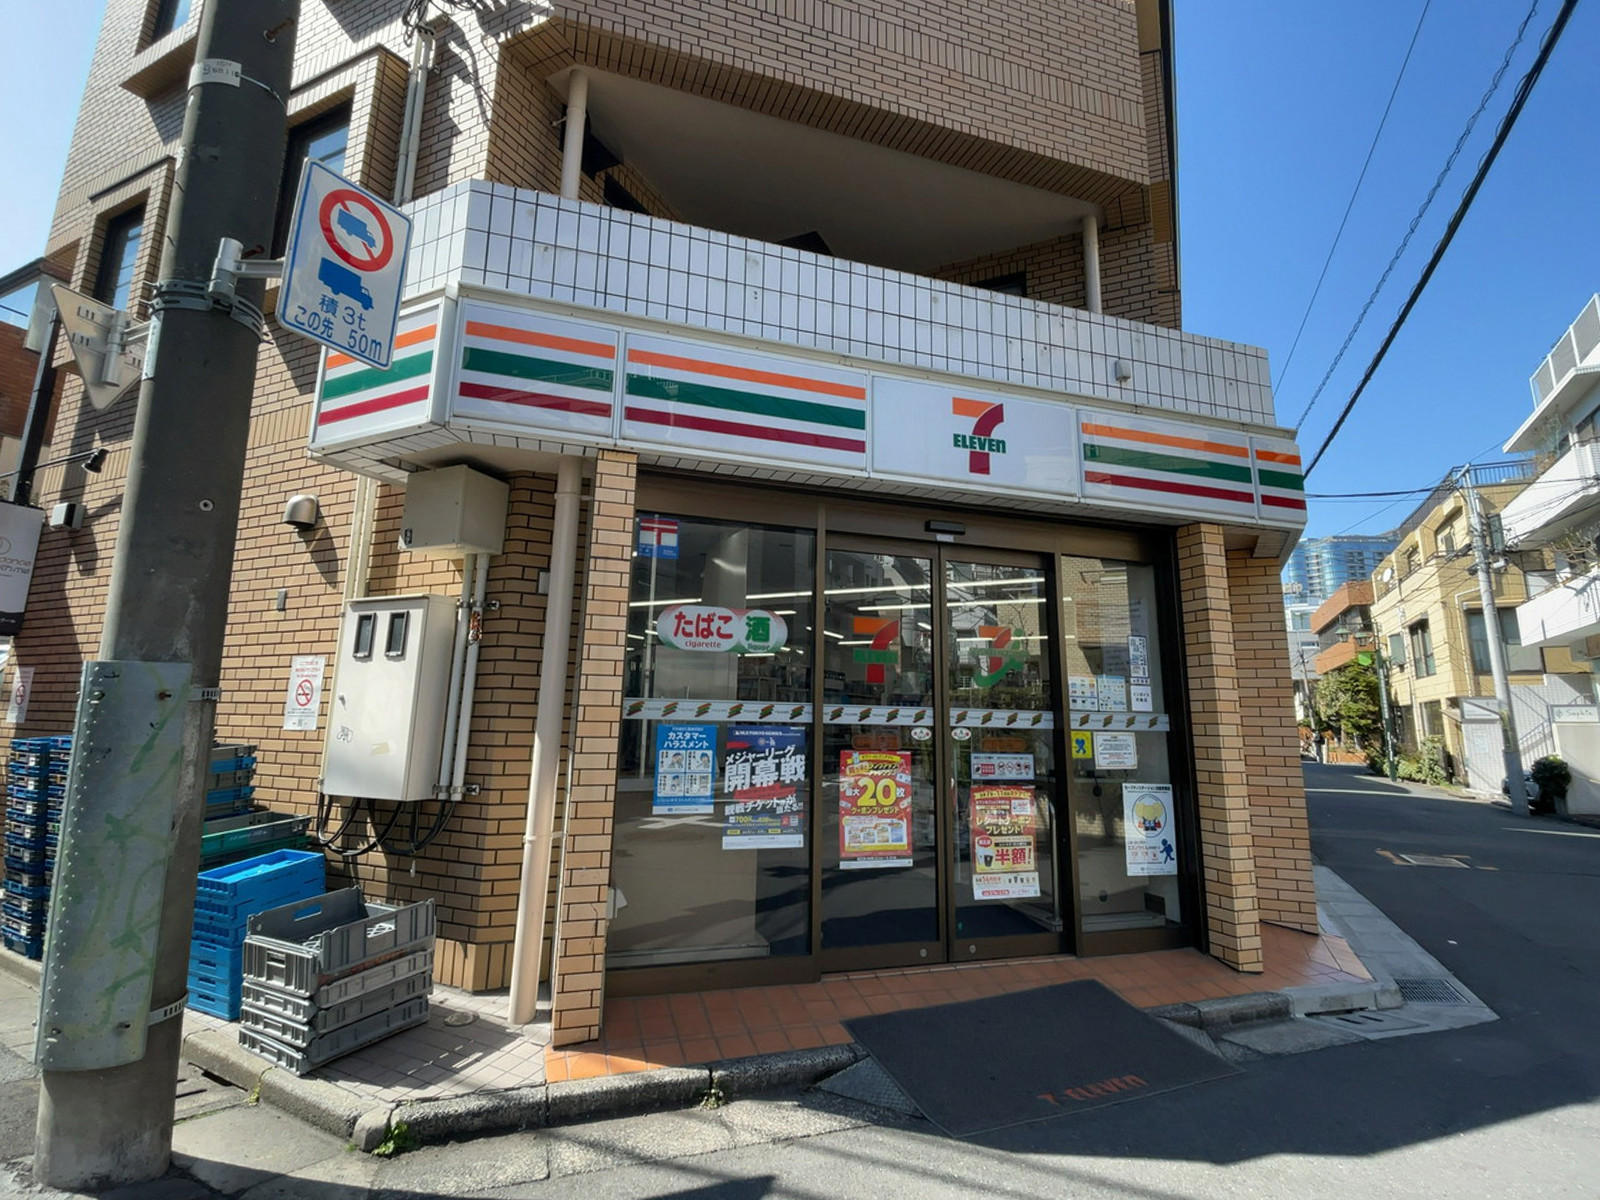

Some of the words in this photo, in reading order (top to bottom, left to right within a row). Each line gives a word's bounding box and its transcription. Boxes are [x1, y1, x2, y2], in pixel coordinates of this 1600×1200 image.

[318, 294, 339, 318] 積
[342, 306, 366, 331] 3t
[294, 305, 334, 339] この先
[347, 329, 382, 361] 50m
[952, 397, 1004, 475] 7
[673, 611, 733, 639] たばこ
[745, 615, 771, 643] 酒
[684, 640, 722, 649] cigarette
[664, 740, 709, 749] ハラスメント
[667, 731, 707, 740] カスタマー
[726, 744, 796, 765] メジャーリーグ
[724, 754, 806, 793] 開幕戦
[857, 777, 897, 807] 20
[994, 848, 1032, 866] 半額!
